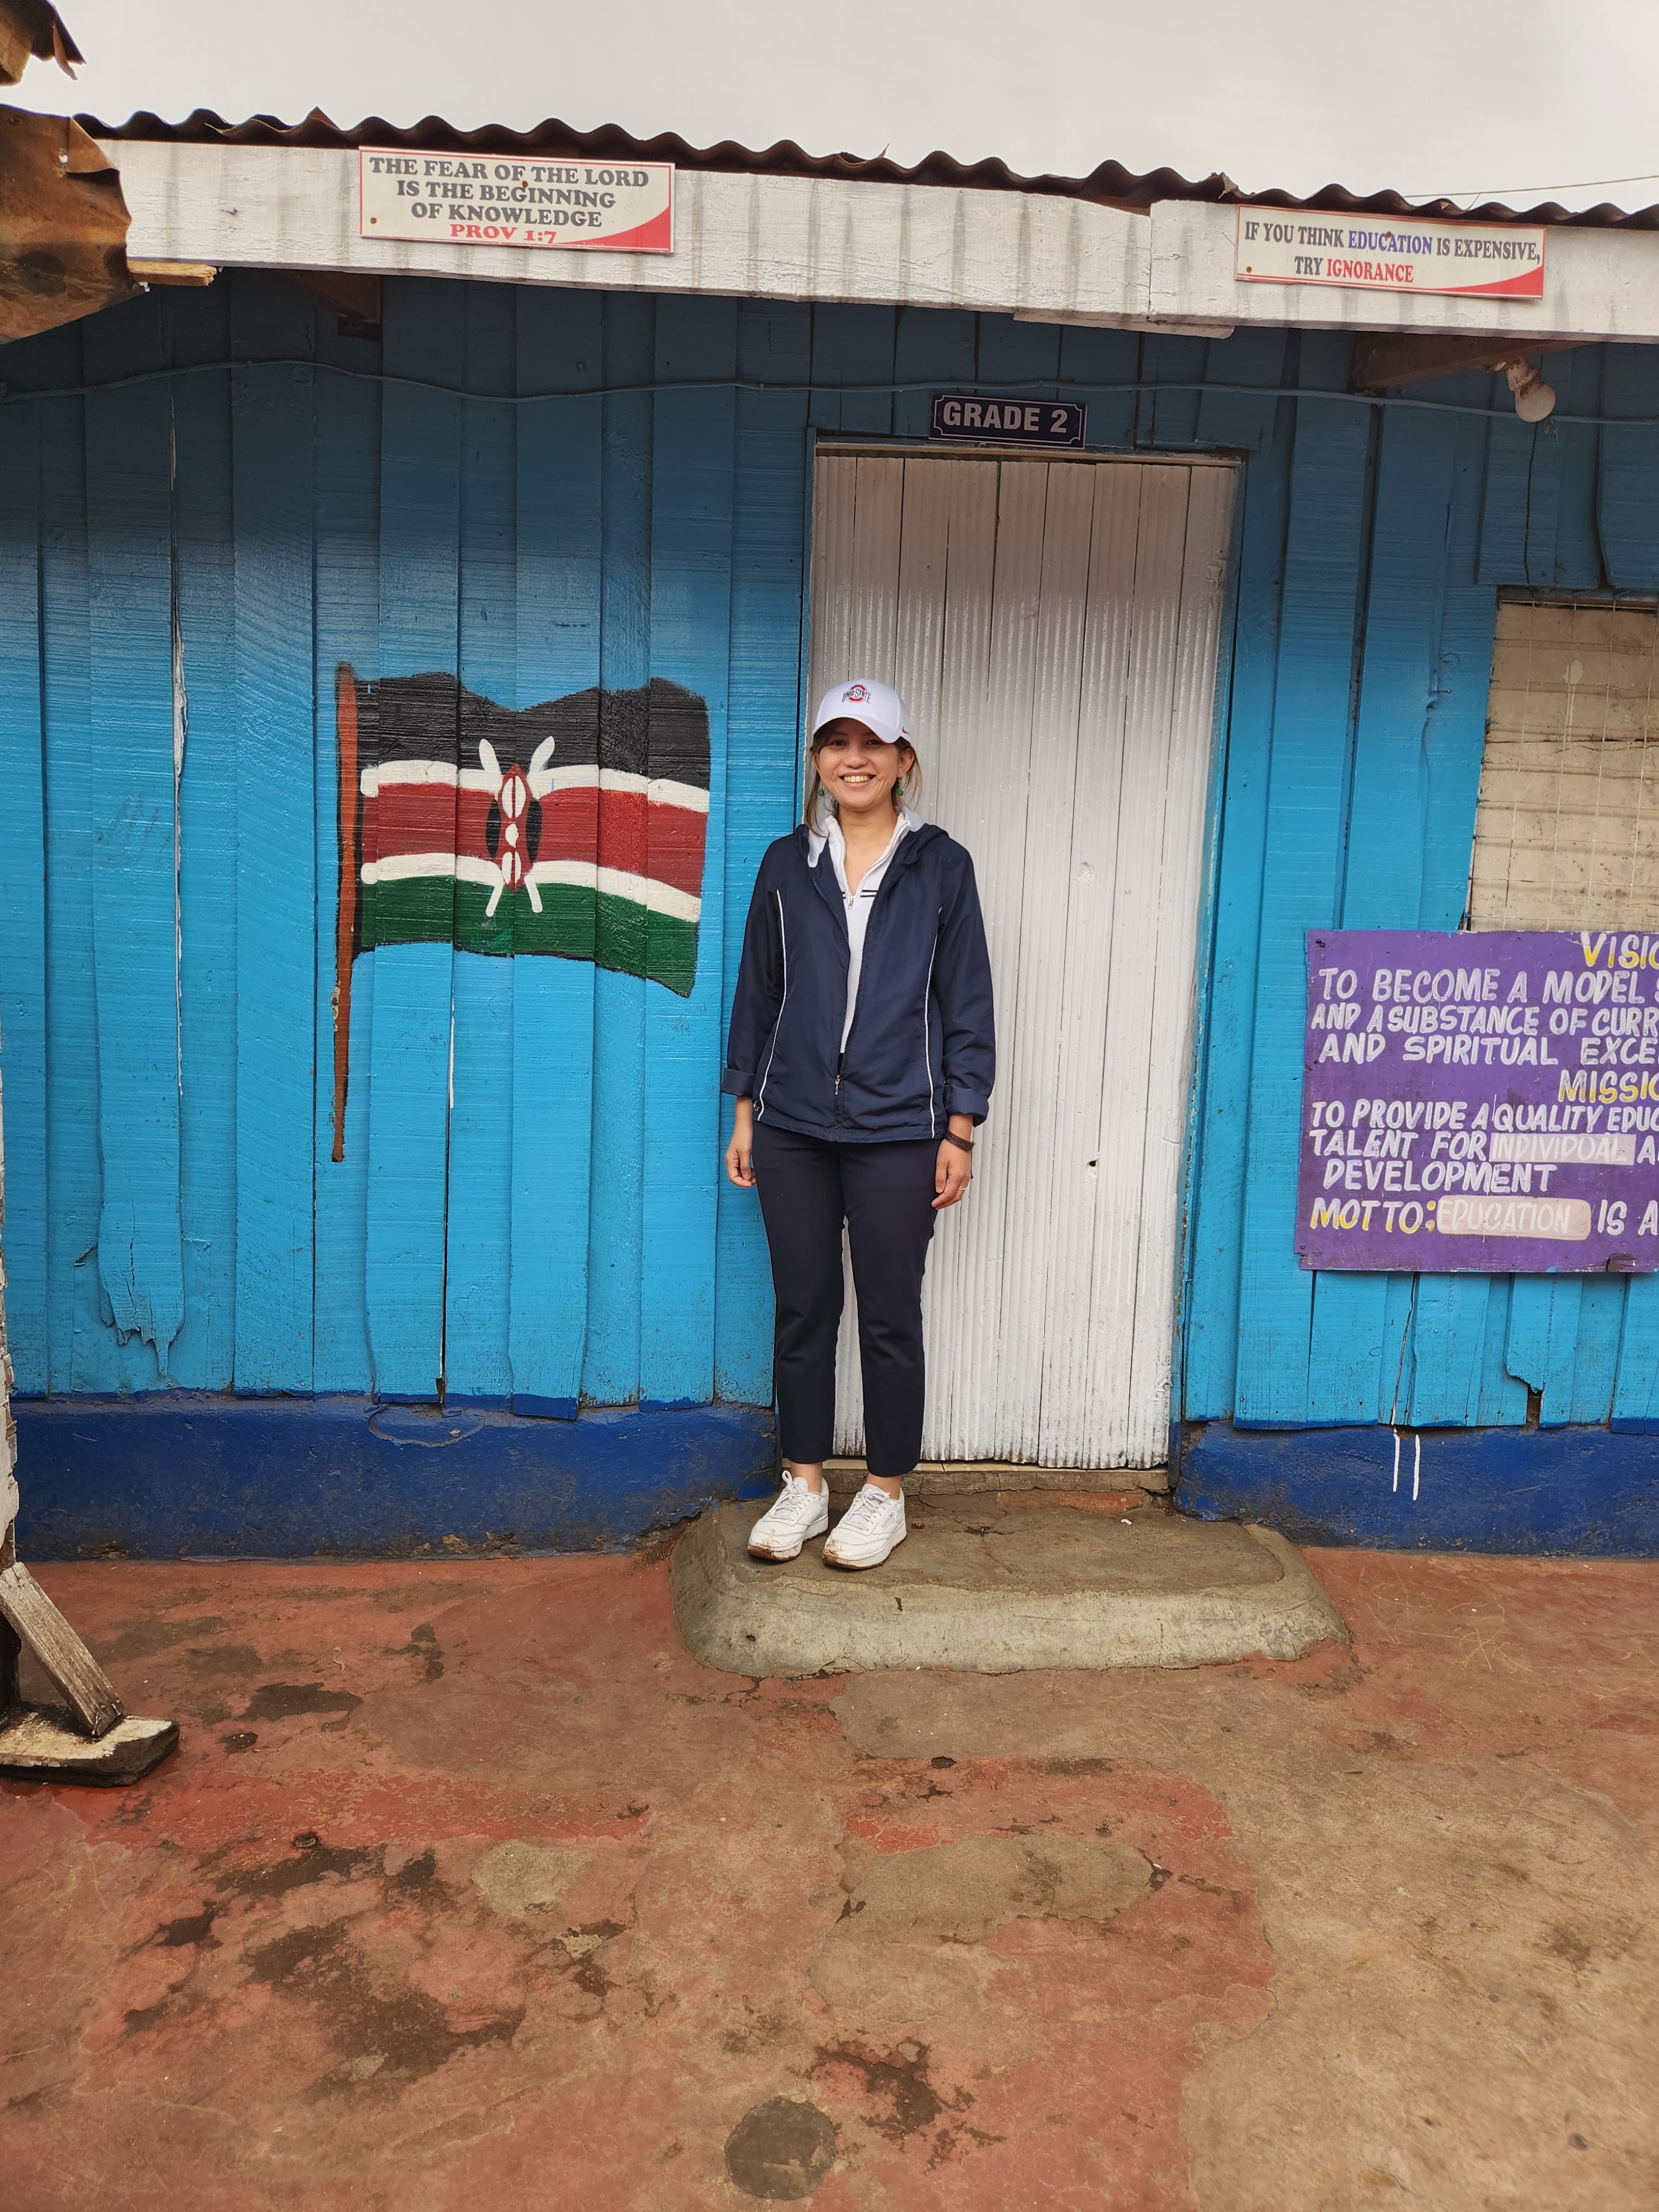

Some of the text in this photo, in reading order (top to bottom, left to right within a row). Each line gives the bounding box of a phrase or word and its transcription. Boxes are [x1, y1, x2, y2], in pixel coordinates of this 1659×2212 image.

[369, 157, 649, 187] THE FEAR OF THE LORD
[397, 180, 616, 208] IS THE BEGINNING
[411, 202, 602, 227] OF KNOWLEDGE
[450, 224, 557, 244] PROV 1:7
[1245, 221, 1540, 265] IF YOU THINK EDUCATION IS EXPENSIVE,
[1294, 255, 1413, 283] TRY IGNORANCE
[943, 401, 1068, 433] GRADE 2
[842, 688, 871, 703] OHIO STATE
[1319, 968, 1358, 1000] TO
[1372, 968, 1501, 1004] BECOME
[1507, 971, 1527, 1004] A
[1542, 970, 1645, 1005] MODEL
[1311, 1002, 1659, 1037] AND A SUBSTANCE OF CURR
[1318, 1032, 1659, 1066] AND SPIRITUAL EXCE
[1312, 1100, 1345, 1128] TO
[1352, 1098, 1468, 1130] PROVIDE
[1471, 1103, 1489, 1130] A
[1494, 1104, 1604, 1133] QUALITY
[1309, 1129, 1659, 1165] TALENT FOR INDIVIDUAL A
[1323, 1160, 1557, 1193] DEVELOPMENT
[1437, 1198, 1571, 1234] EDUCATION
[1597, 1199, 1627, 1235] IS
